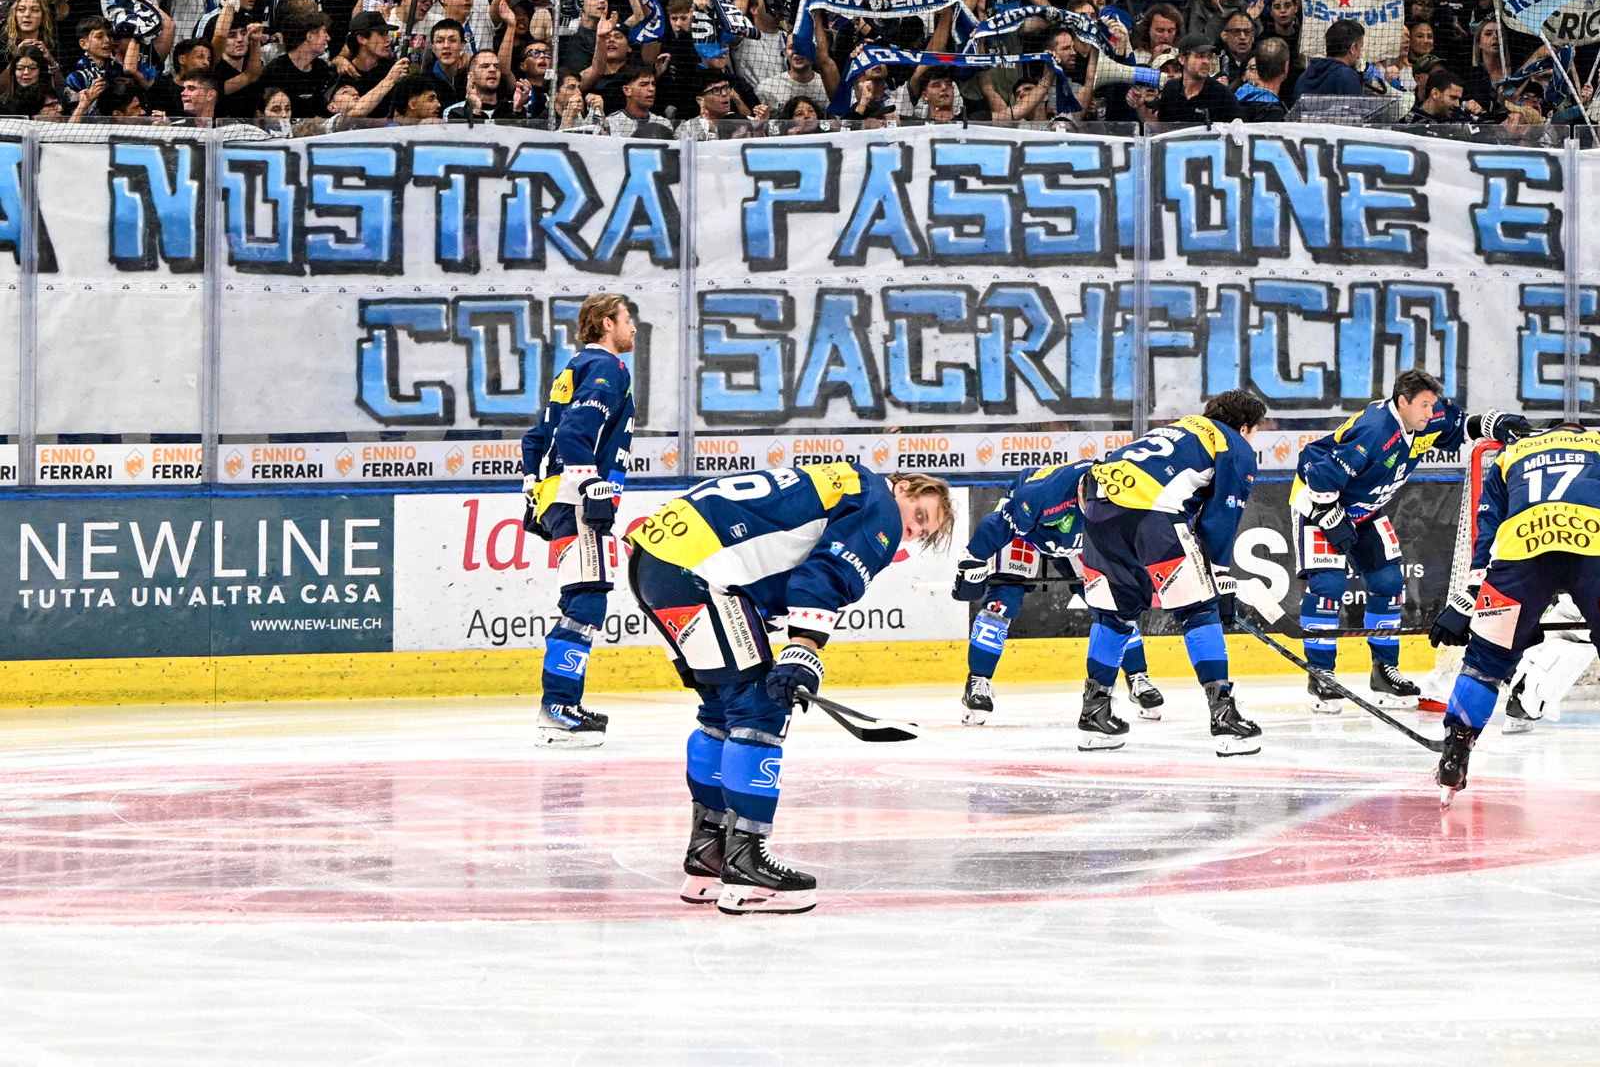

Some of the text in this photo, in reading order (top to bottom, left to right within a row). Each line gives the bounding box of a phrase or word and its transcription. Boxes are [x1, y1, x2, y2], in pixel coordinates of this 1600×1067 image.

[110, 137, 682, 275] NOSTRA
[743, 137, 1429, 271] PASSIONE
[1469, 149, 1567, 269] E
[697, 278, 1468, 426] SACRIFICIO
[793, 439, 845, 453] ENNIO
[899, 437, 949, 452] ENNIO
[1001, 437, 1052, 451] ENNIO
[41, 448, 95, 463] ENNIO
[251, 447, 306, 462] ENNIO
[362, 446, 416, 460] ENNIO
[899, 453, 965, 467] FERRARI
[1001, 452, 1068, 467] FERRARI
[1523, 452, 1587, 470] MÜLLER
[40, 465, 113, 480] FERRARI
[152, 464, 202, 479] FERRA
[251, 463, 323, 479] FERRARI
[362, 462, 433, 477] FERRARI
[1523, 464, 1585, 503] 17
[1515, 514, 1600, 538] CHICCO
[1525, 529, 1592, 553] D'ORO
[19, 518, 381, 581] NEWLINE
[1312, 556, 1333, 564] Studio
[1008, 562, 1026, 574] Studio
[19, 583, 381, 609] TUTTA UN'ALTRA CASA
[251, 618, 381, 632] WWW.NEW-LINE.CH
